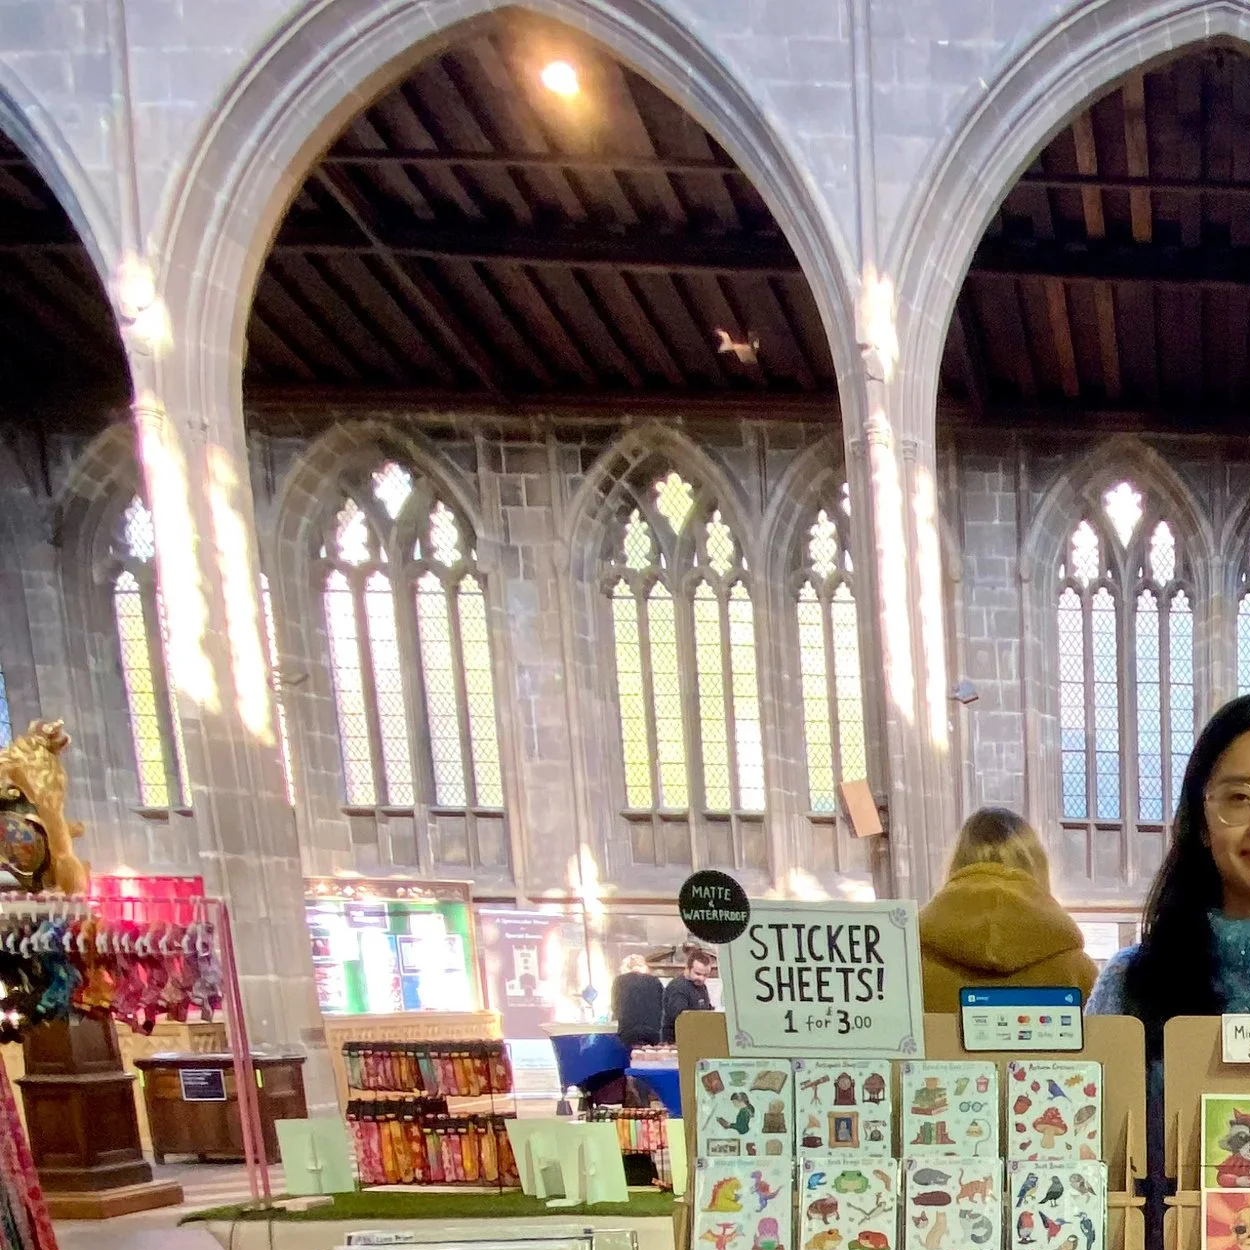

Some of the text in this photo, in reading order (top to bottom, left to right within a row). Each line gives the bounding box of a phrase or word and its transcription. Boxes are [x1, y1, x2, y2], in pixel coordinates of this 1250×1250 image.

[691, 885, 732, 900] MATTE
[682, 909, 748, 922] WATERPROOF
[749, 923, 885, 964] STICKER
[754, 966, 885, 1002] SHEETS!
[784, 1010, 798, 1033] 1
[805, 1014, 832, 1031] for
[1008, 1062, 1016, 1072] 4
